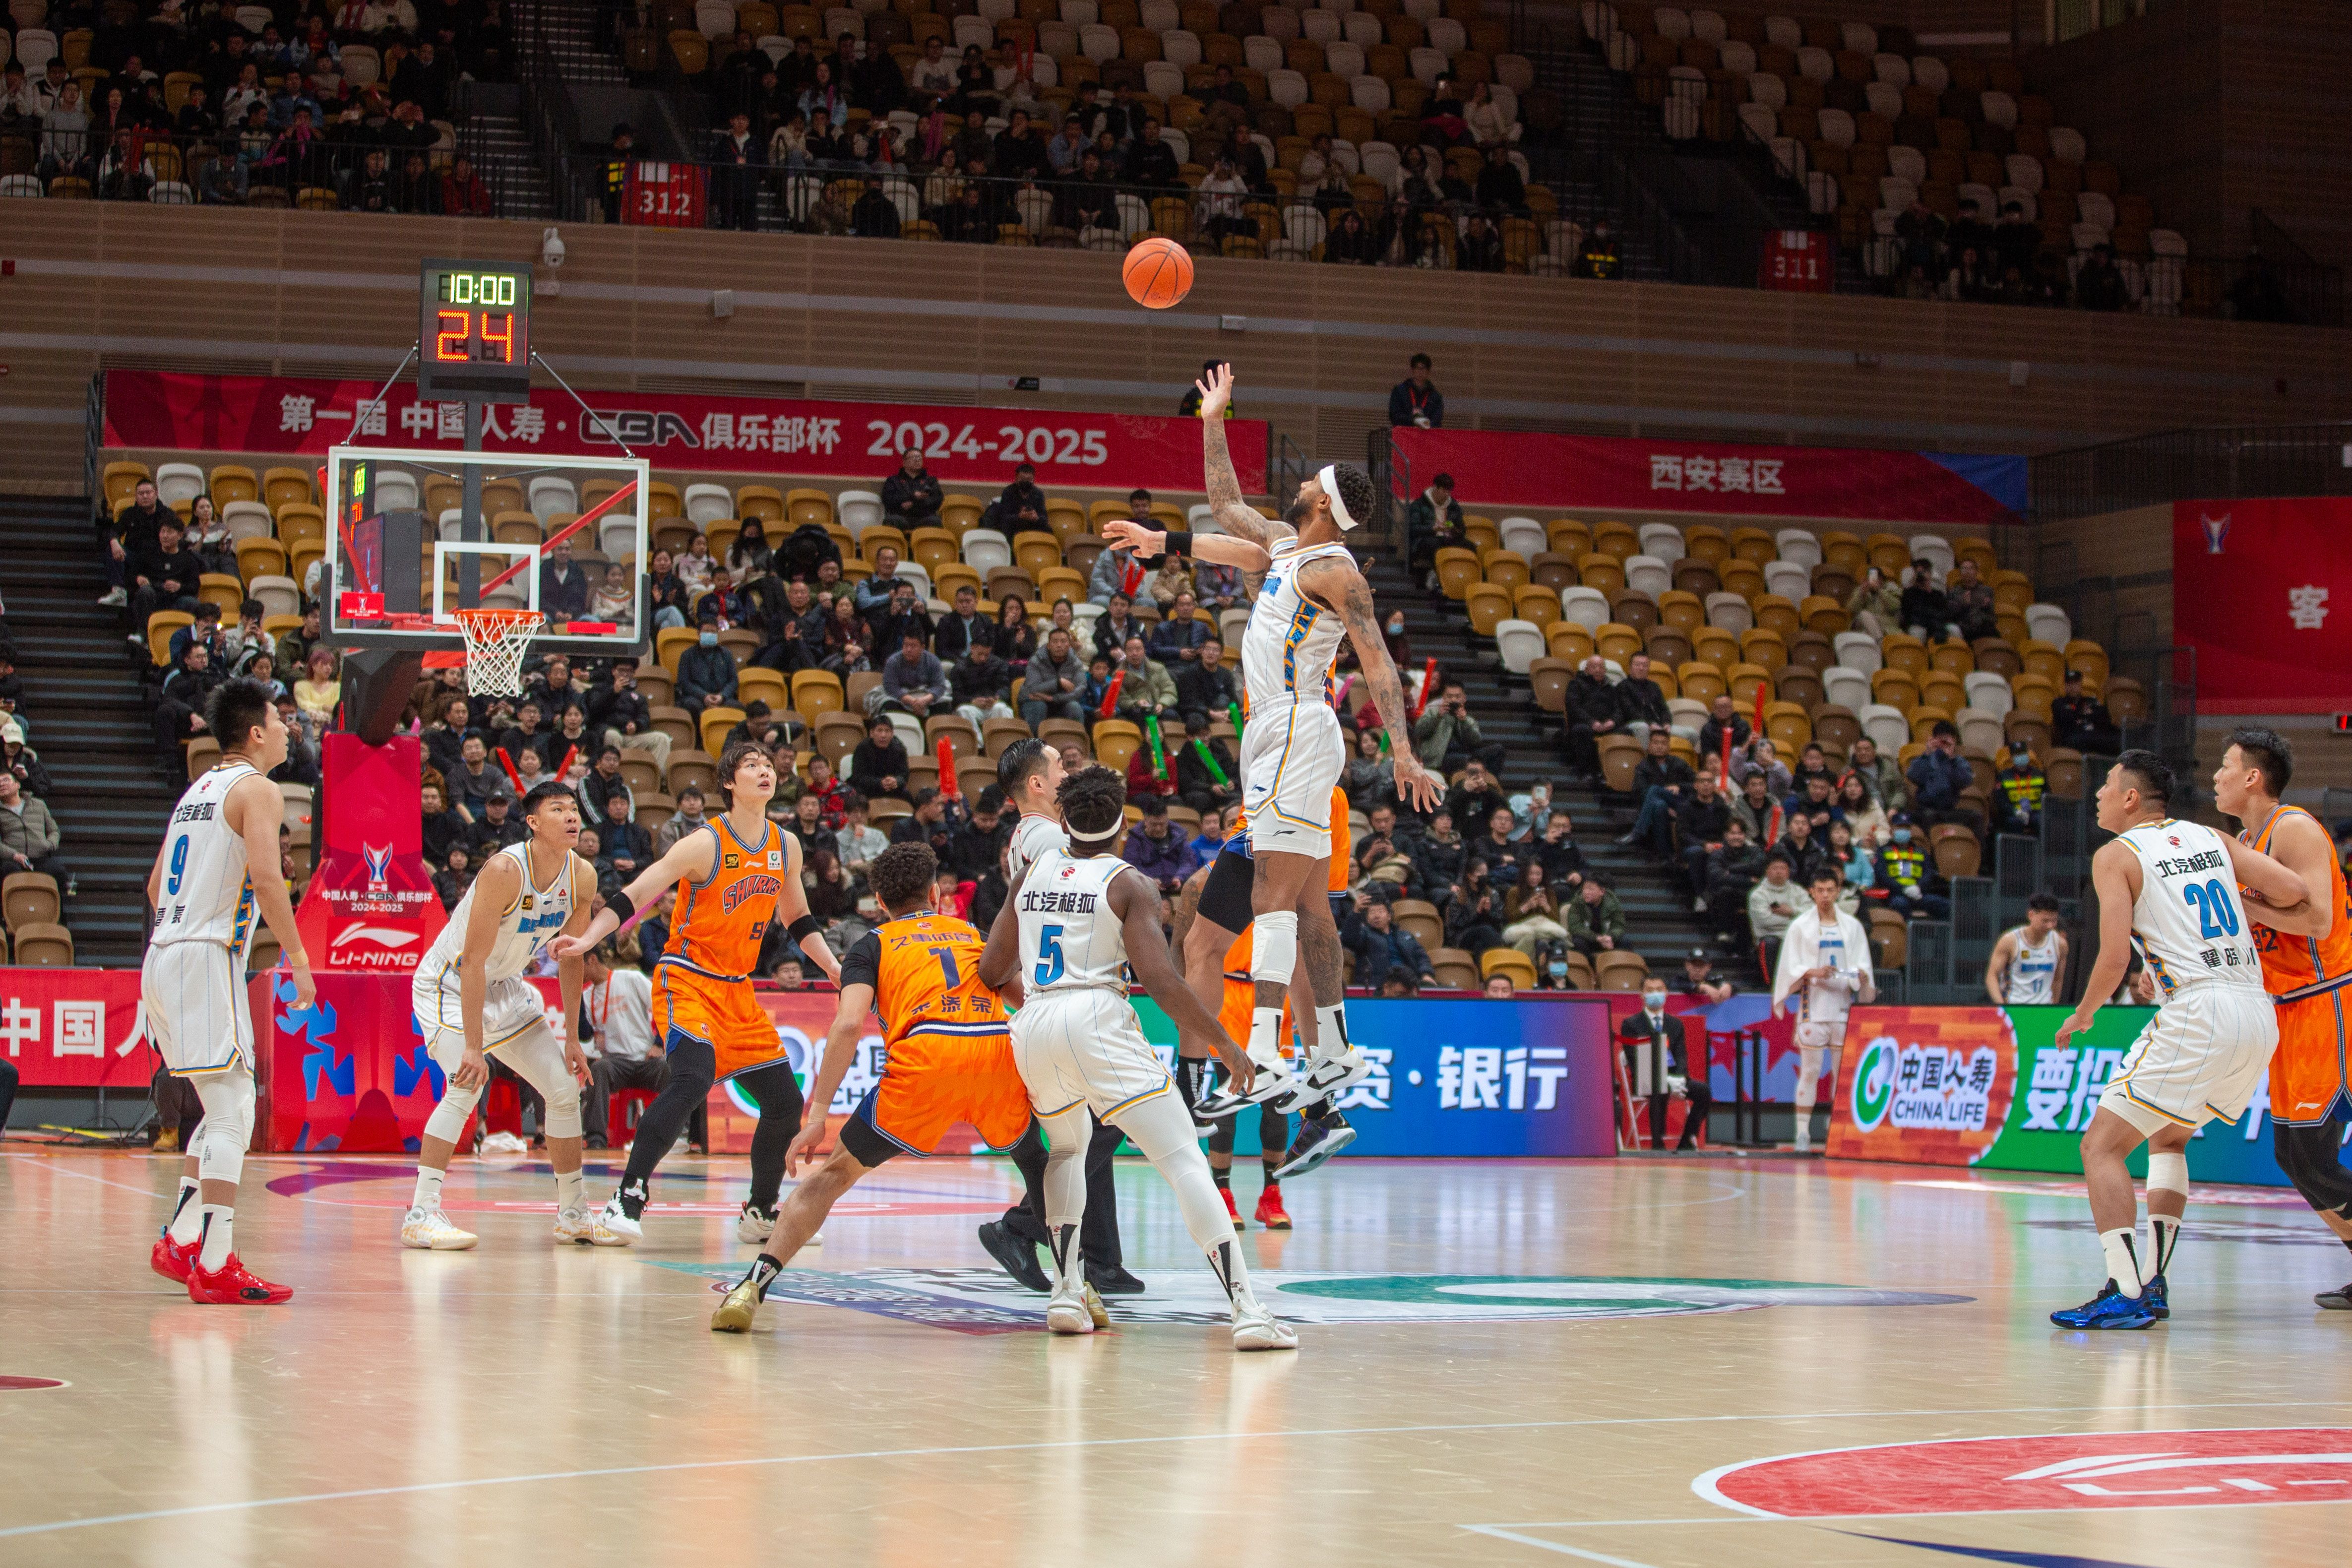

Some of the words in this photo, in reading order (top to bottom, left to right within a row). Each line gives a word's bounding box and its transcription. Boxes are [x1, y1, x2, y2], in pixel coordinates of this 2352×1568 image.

[639, 190, 690, 216] 312
[1773, 256, 1818, 280] 311
[450, 273, 515, 306] 10:00
[437, 310, 513, 364] 24
[279, 394, 387, 437] 第一届
[867, 420, 1108, 466] 2024-2025
[1650, 454, 1786, 495] 西安赛区
[2288, 583, 2329, 630] 客
[168, 834, 189, 895] 9
[2156, 849, 2224, 878] 北汽极狐
[368, 882, 388, 892] 第一届
[723, 874, 782, 916] SHARKS
[1022, 890, 1098, 914] 北汽极狐
[351, 903, 403, 913] 2024-2025
[2184, 878, 2239, 941] 20
[890, 932, 973, 951] 久事体育
[1035, 925, 1064, 986] 5
[2200, 947, 2256, 968] 翟晓川
[329, 951, 419, 966] LI-NING
[928, 946, 961, 991] 1
[1901, 1052, 1993, 1093] 中国人寿
[1895, 1099, 1943, 1121] CHINA
[1949, 1103, 1984, 1123] LIFE
